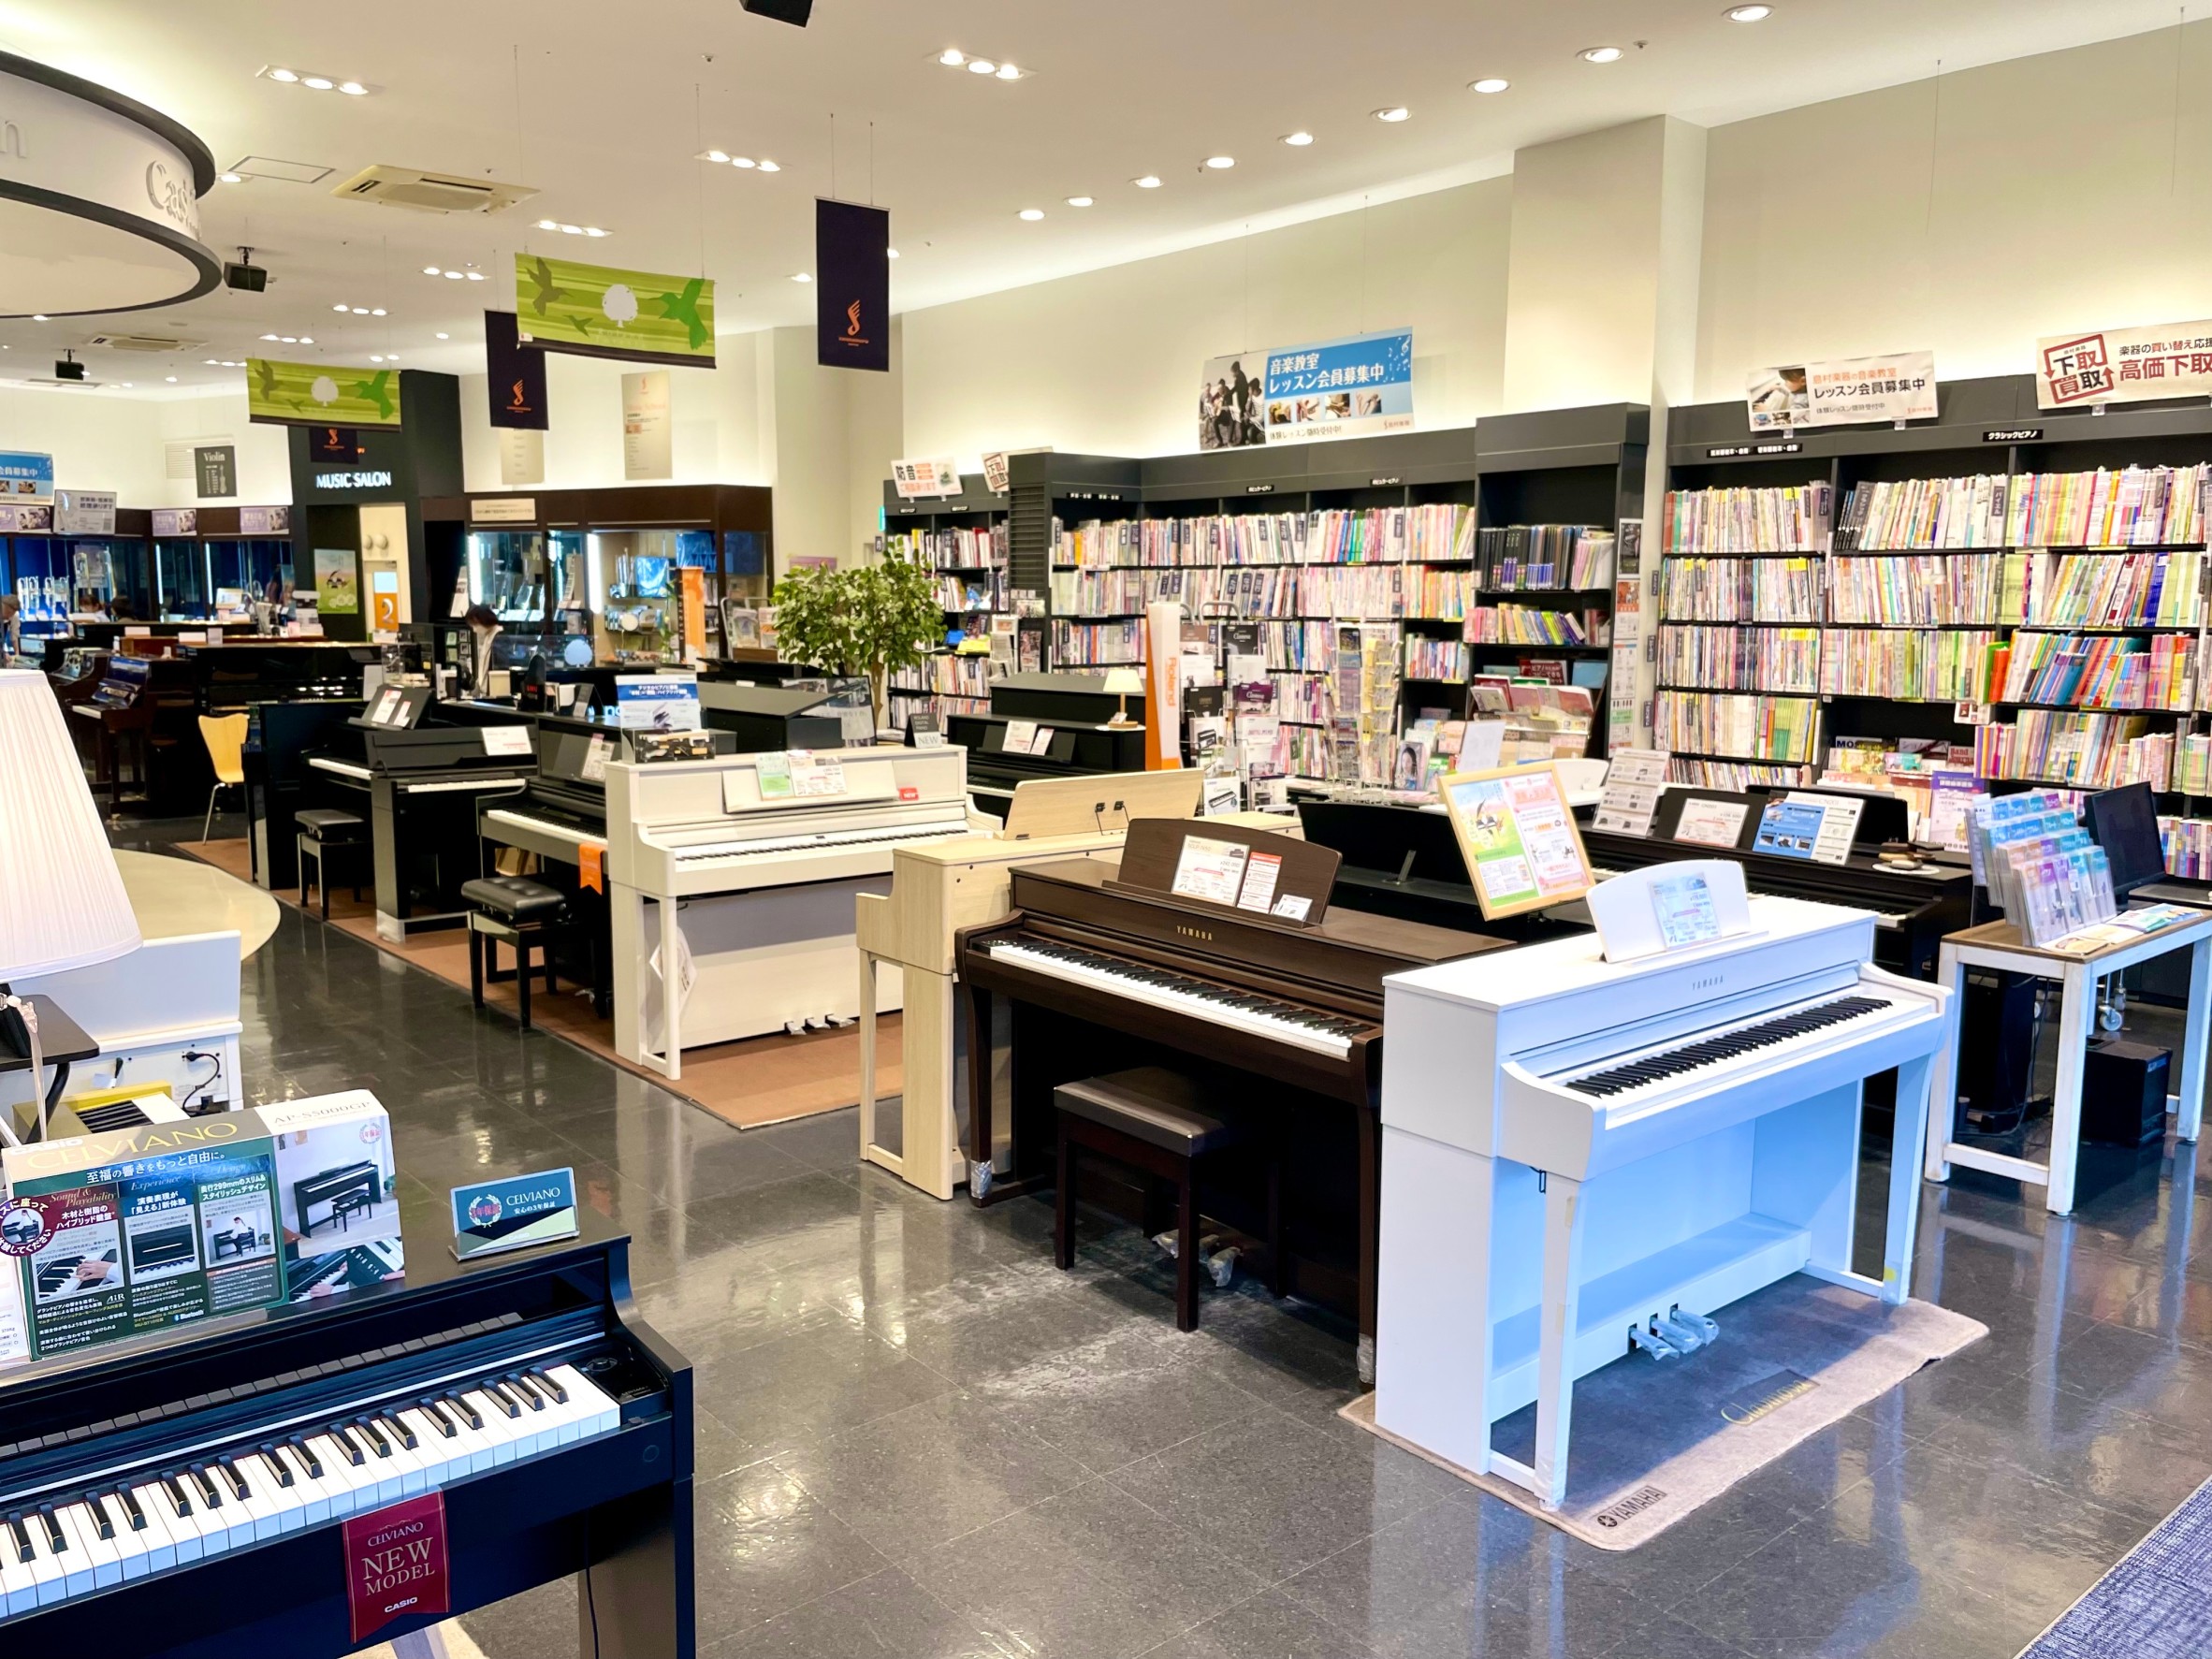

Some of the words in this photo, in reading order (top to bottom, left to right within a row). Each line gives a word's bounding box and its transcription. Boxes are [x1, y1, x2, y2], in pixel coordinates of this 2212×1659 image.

[1270, 352, 1320, 376] 音楽教室
[2054, 351, 2100, 376] 下取
[2119, 353, 2212, 383] 高価下取
[1269, 362, 1385, 395] レッスン会員募集中
[2059, 370, 2104, 397] 買取
[1813, 377, 1926, 400] レッスン会員募集中
[1988, 430, 2038, 441] クラシックピアノ
[203, 451, 226, 461] Violin
[316, 473, 352, 488] MUSIC
[353, 471, 392, 488] SALON
[1167, 657, 1177, 706] Roland
[918, 735, 939, 745] NEW
[1176, 924, 1213, 941] YAMAHA
[1693, 974, 1724, 991] YAMAHA
[10, 1138, 83, 1156] CASIO
[28, 1123, 238, 1169] CELVIANO
[86, 1151, 226, 1185] 至福の響きをもっと自由に。
[131, 1174, 182, 1191] Experience
[50, 1189, 80, 1204] Sound
[65, 1191, 117, 1208] Playability
[137, 1190, 179, 1206] 演奏表現が
[202, 1183, 266, 1201] スタイリッシュデザイン
[506, 1186, 561, 1206] CELVIANO
[514, 1201, 557, 1215] 安心の3年保証
[107, 1293, 125, 1304] AiR
[1607, 1489, 1661, 1521] YAMAHA
[368, 1521, 424, 1547] CELVIANO
[361, 1536, 434, 1580] NEW
[365, 1563, 436, 1596] MODEL
[385, 1596, 418, 1613] CASIO
